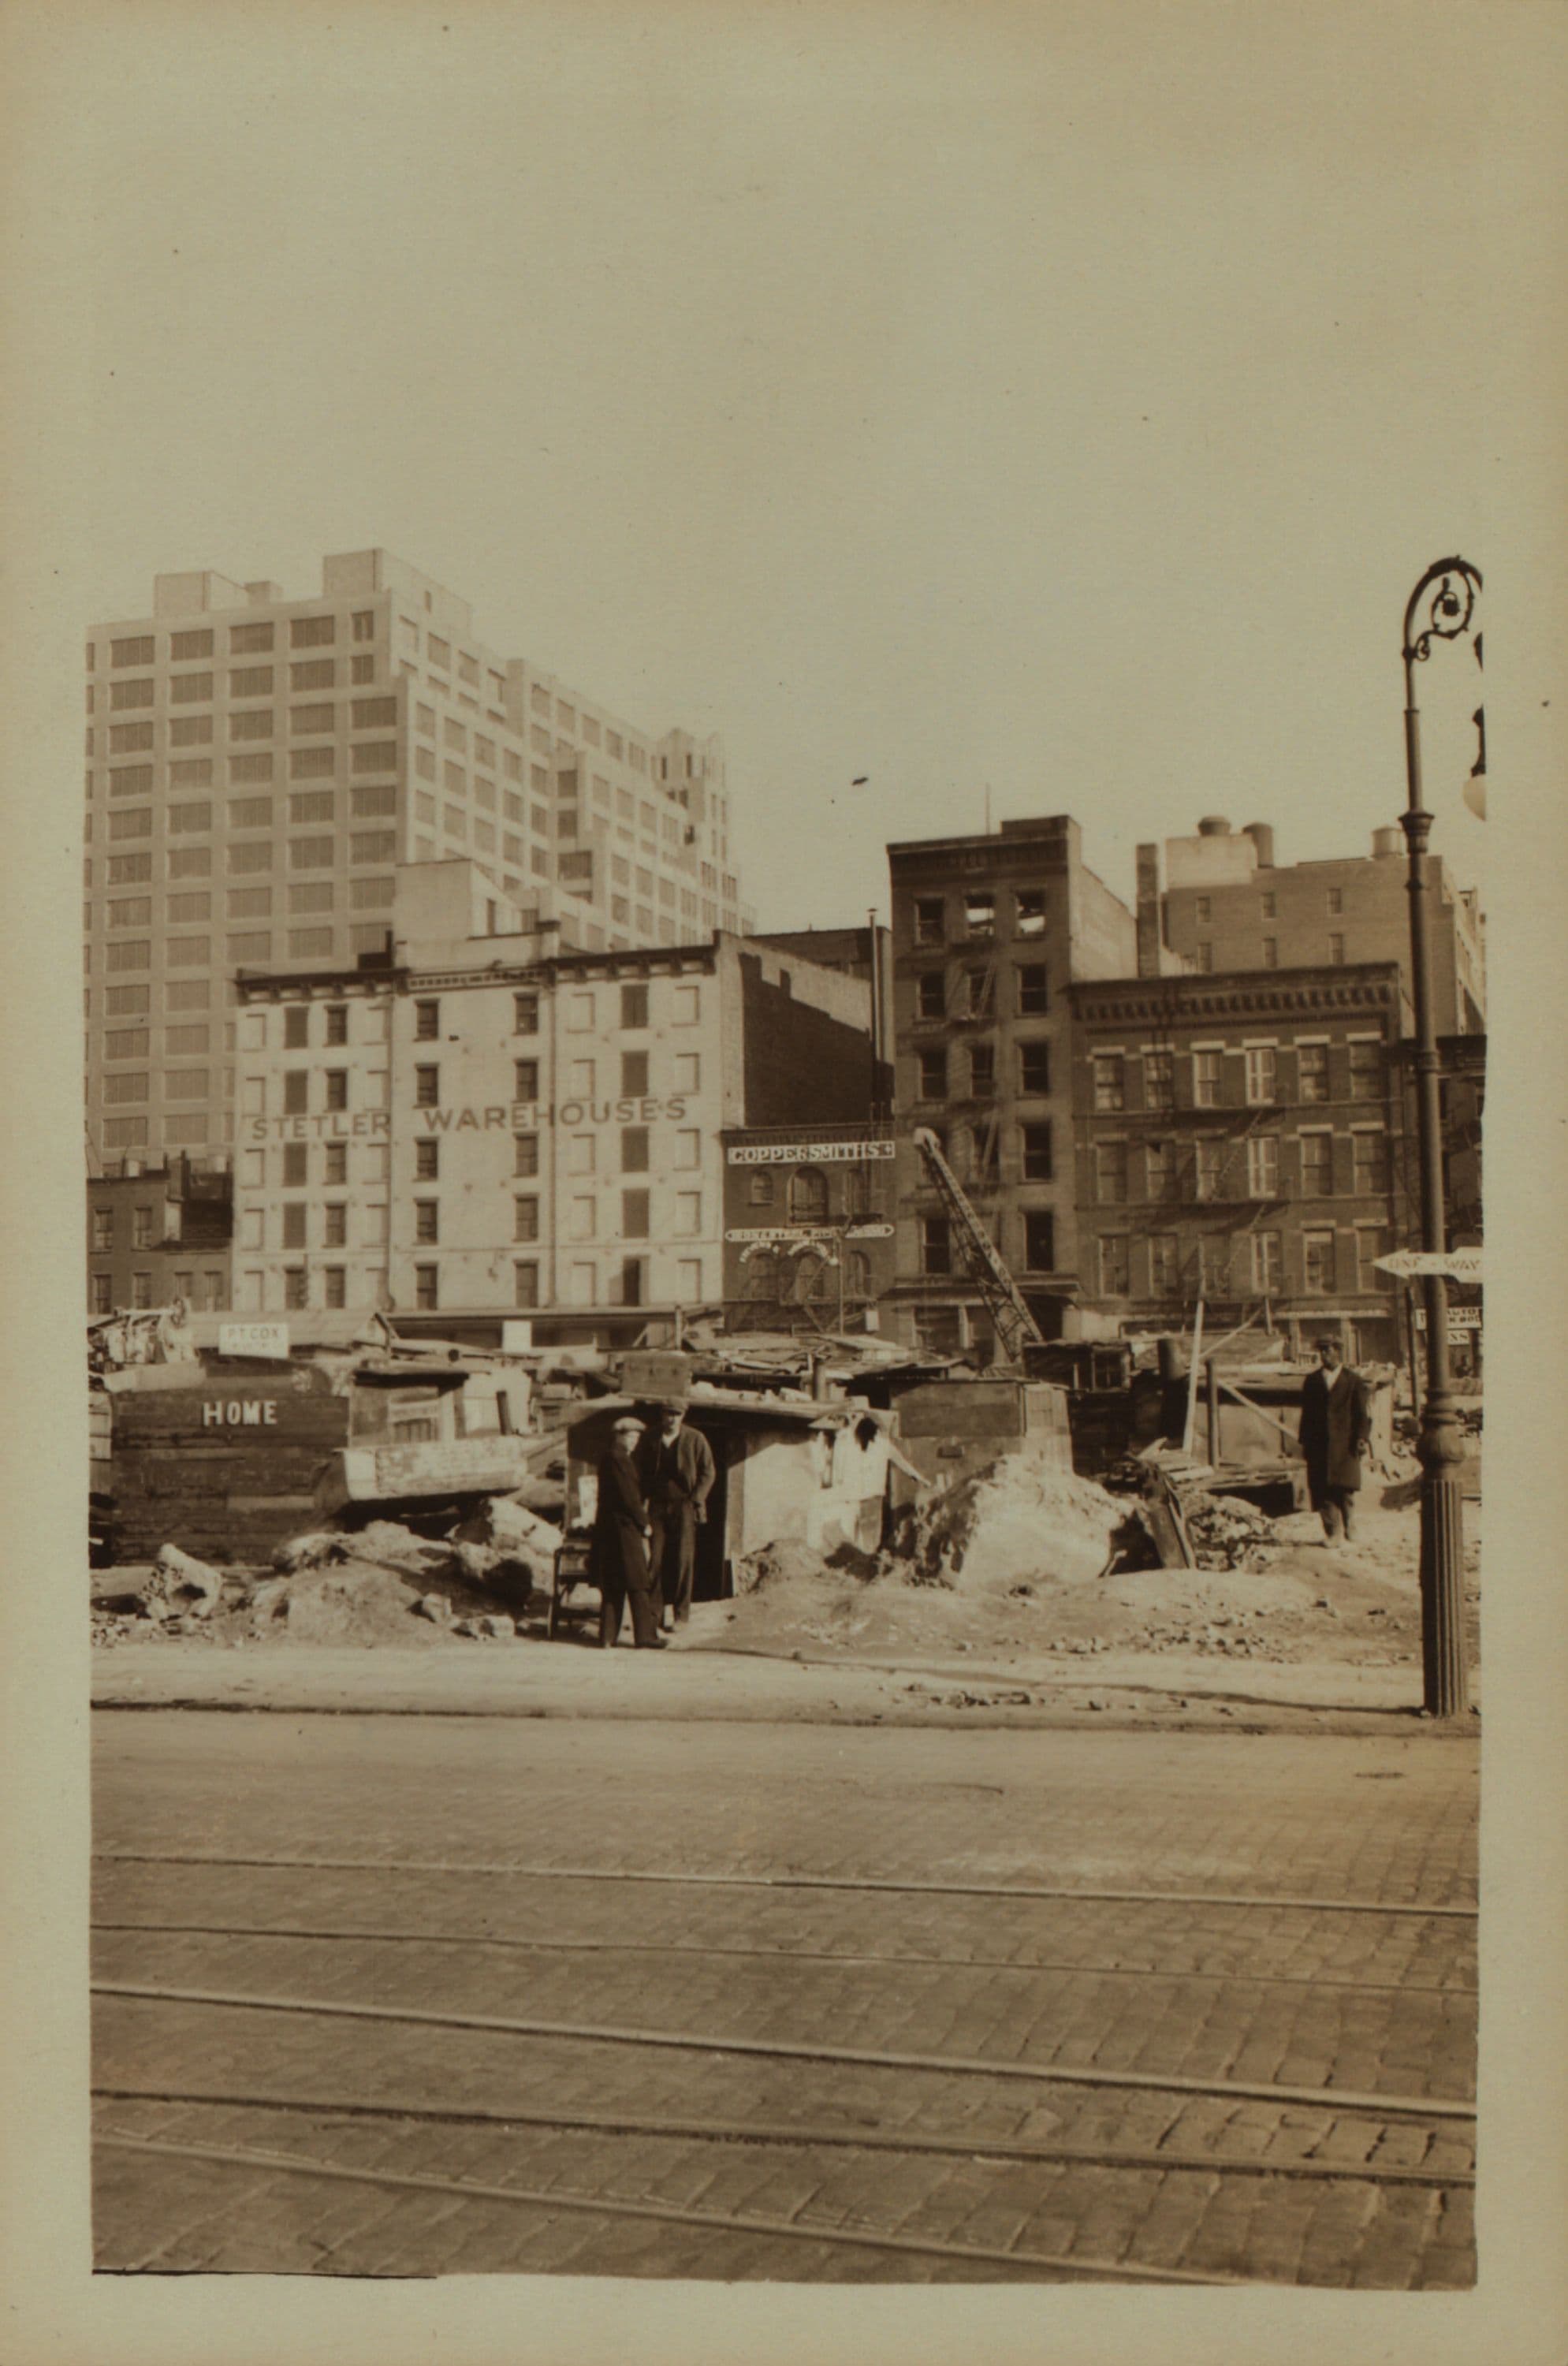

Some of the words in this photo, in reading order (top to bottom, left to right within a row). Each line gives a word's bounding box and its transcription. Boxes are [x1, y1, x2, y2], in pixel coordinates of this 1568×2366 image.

[252, 1113, 391, 1140] STETLER
[424, 1097, 686, 1131] WAREHOUSES
[732, 1143, 880, 1163] COPPERSMITHS
[203, 1399, 277, 1426] HOME
